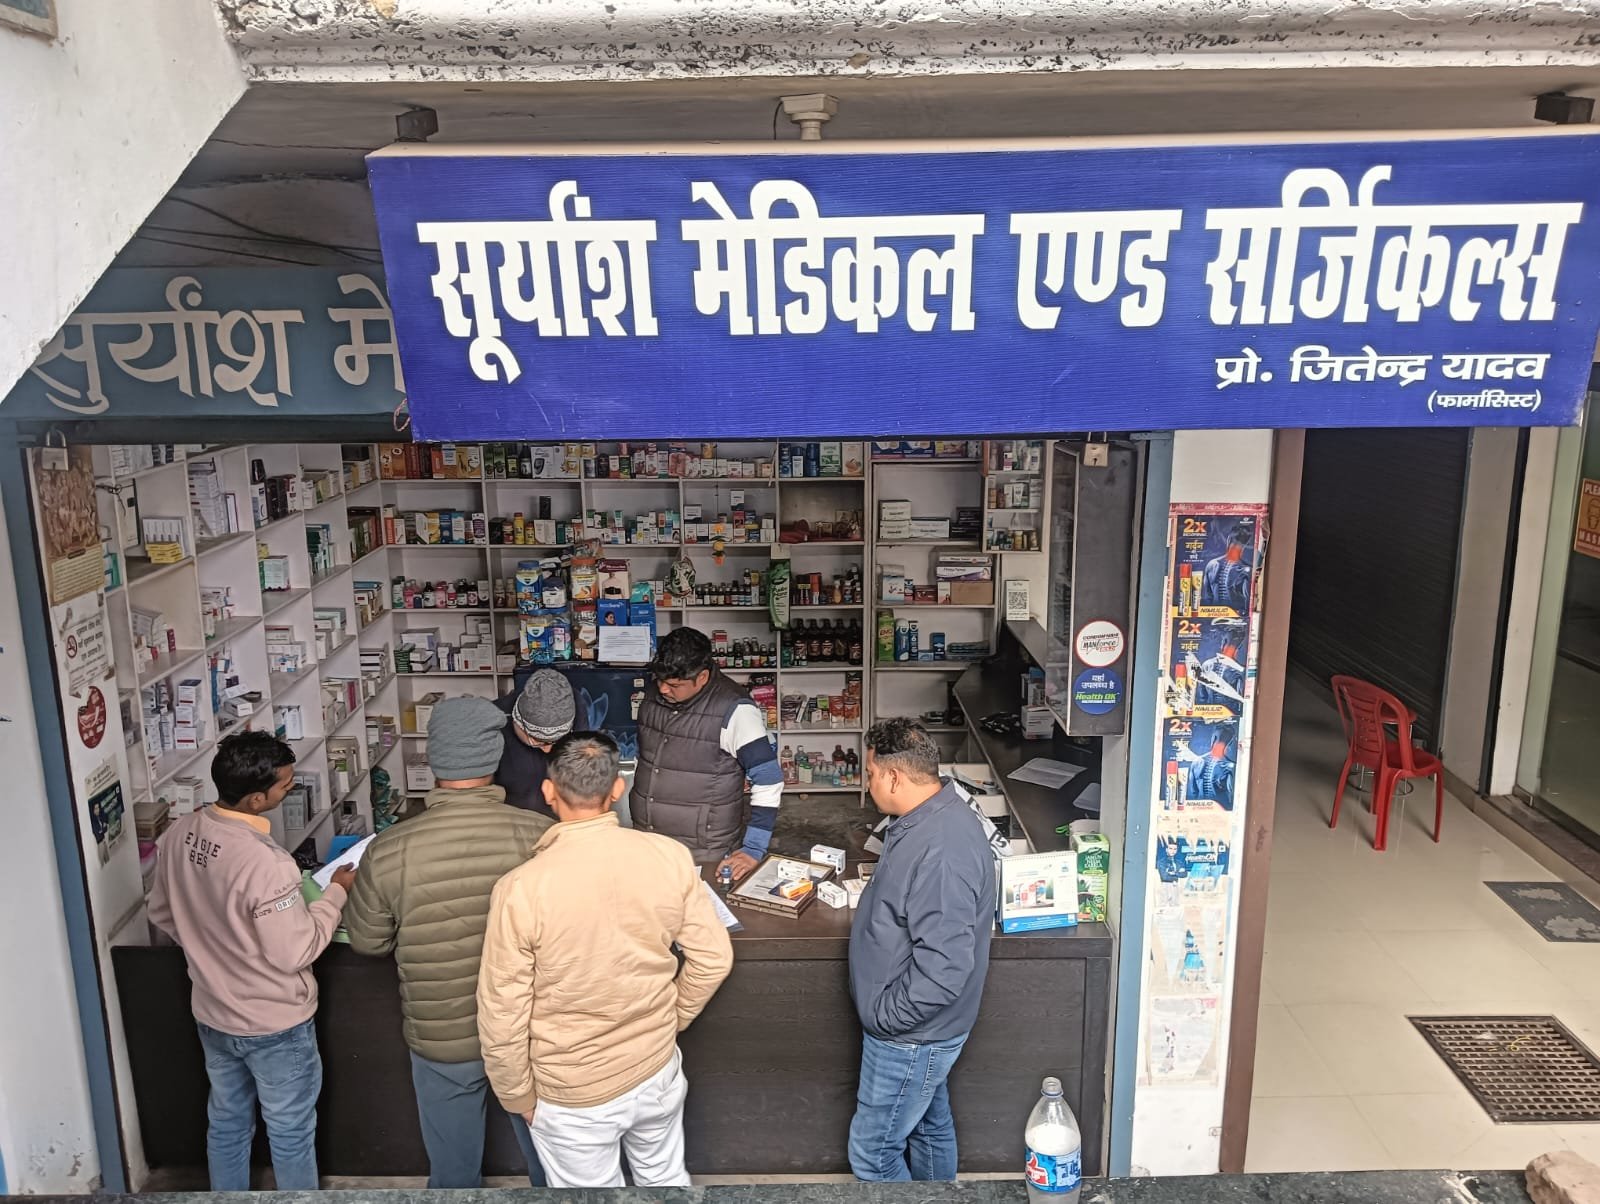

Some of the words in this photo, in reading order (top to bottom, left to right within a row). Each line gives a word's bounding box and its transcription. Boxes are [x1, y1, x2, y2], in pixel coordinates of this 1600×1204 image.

[417, 180, 658, 384] सूर्यांश
[681, 180, 985, 335] मेडिकल
[1010, 209, 1182, 330] एण्ड
[1204, 165, 1584, 326] सर्जिकल्स
[1216, 347, 1273, 389] प्रो.
[1289, 345, 1433, 387] जितेन्द्र
[1442, 353, 1551, 380] यादव
[1427, 389, 1542, 413] (फार्मासिस्ट)
[1075, 692, 1103, 700] Health
[1104, 692, 1117, 700] OK
